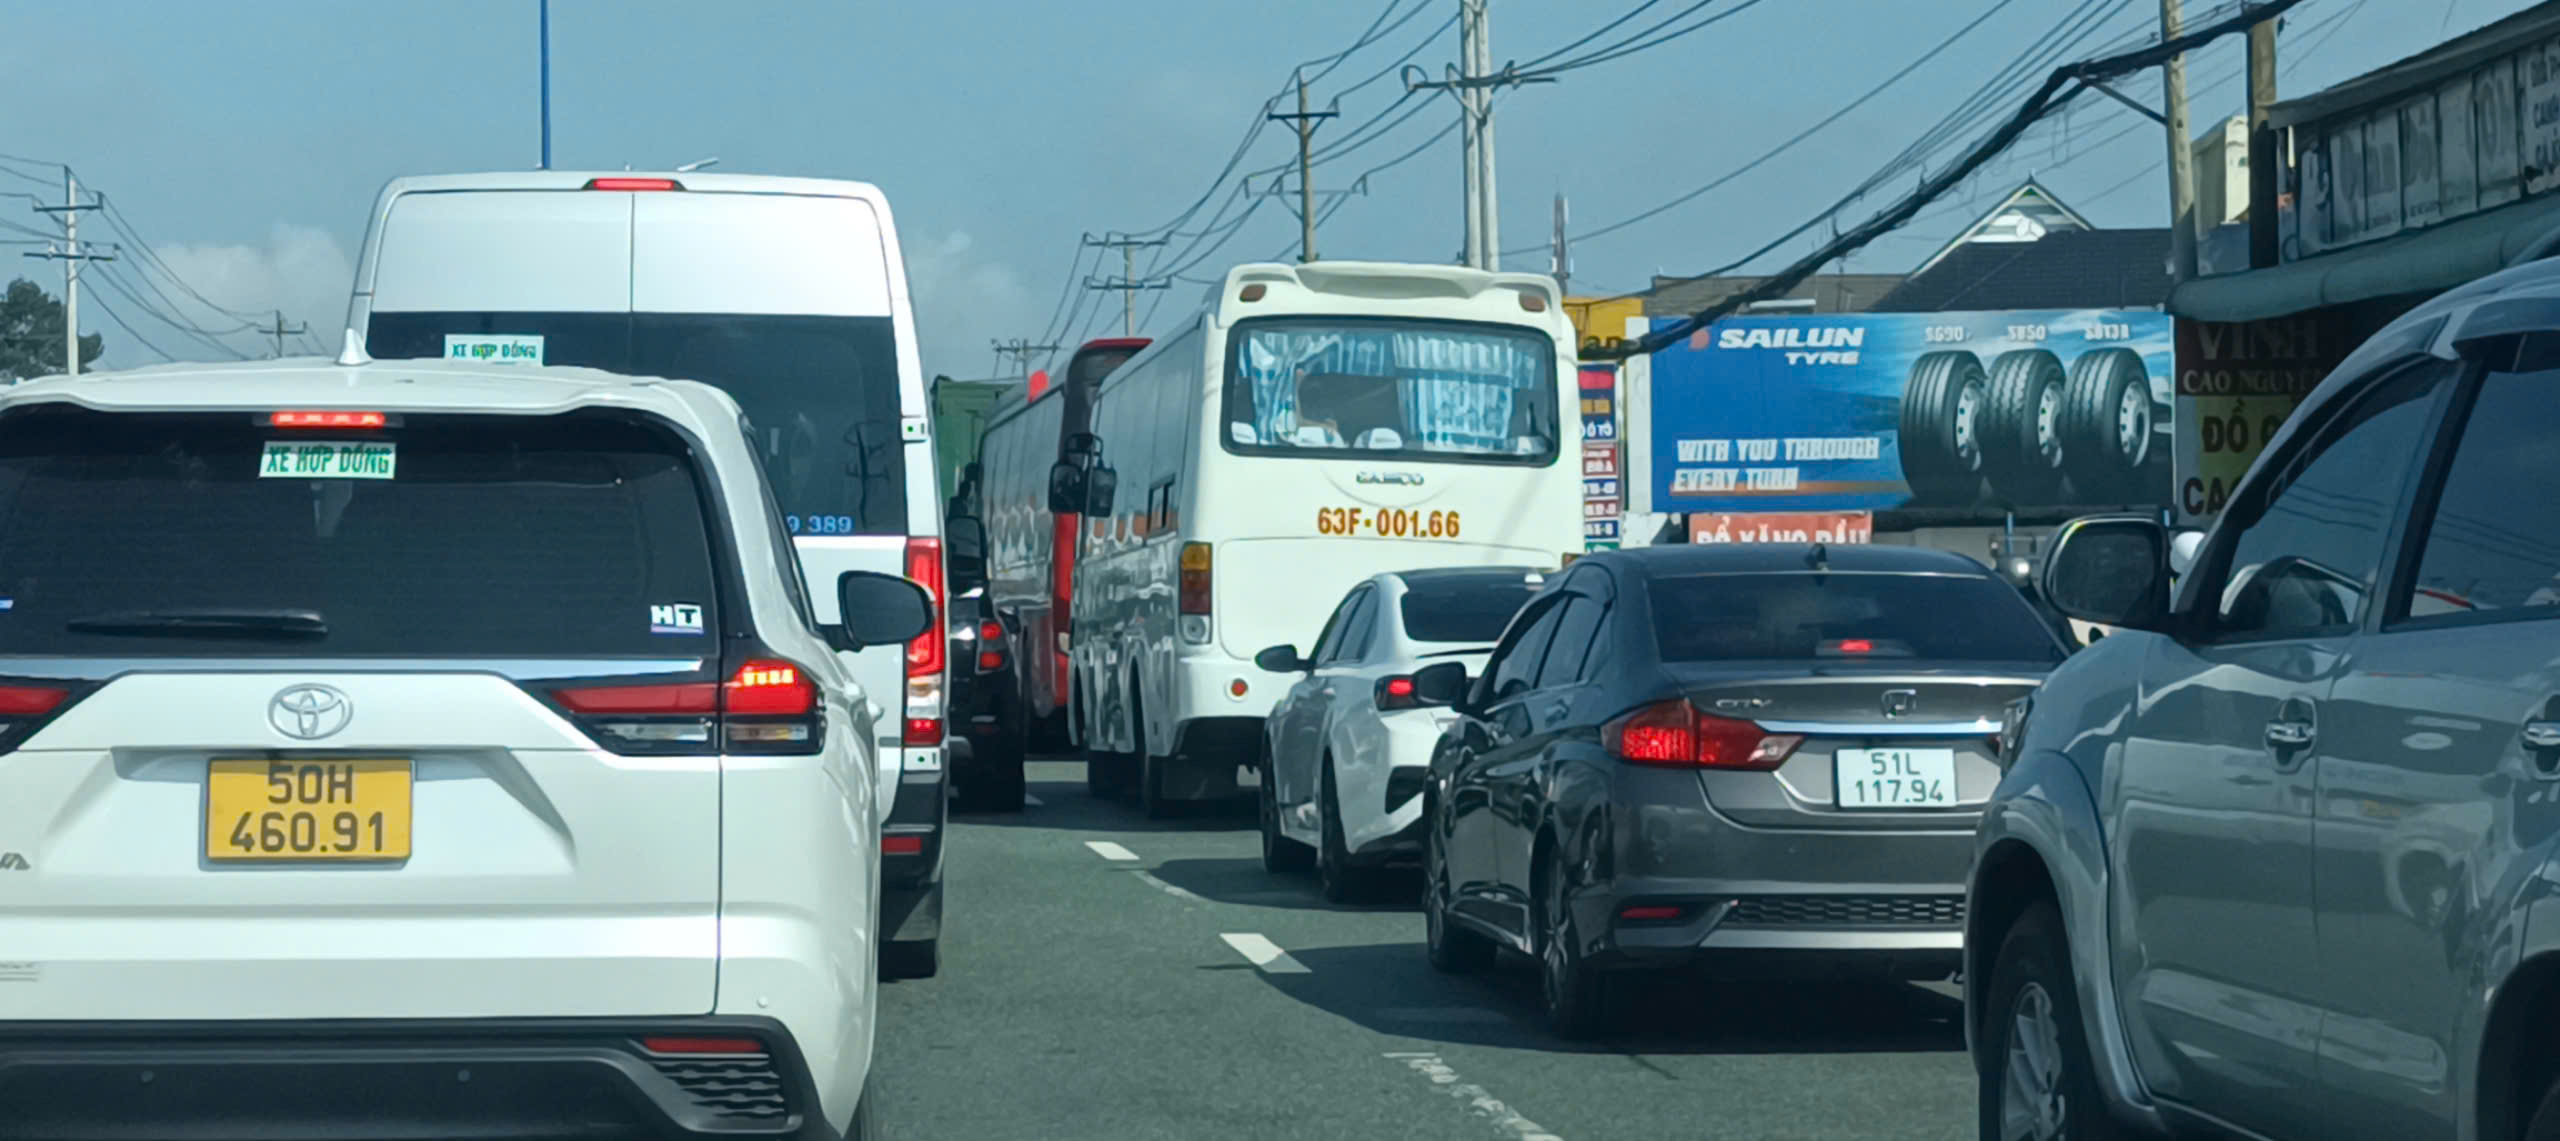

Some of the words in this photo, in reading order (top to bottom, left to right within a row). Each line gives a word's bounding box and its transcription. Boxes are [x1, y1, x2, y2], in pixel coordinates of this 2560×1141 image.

[1718, 327, 1865, 348] SAILUN
[1785, 351, 1859, 365] TYRE
[2183, 369, 2231, 393] CAO
[2202, 398, 2249, 454] ĐỒ
[266, 446, 290, 473] XE
[295, 443, 335, 474] HỢP
[1677, 439, 1731, 462] WITH
[1736, 438, 1779, 461] YOU
[1673, 468, 1739, 491] EVERY
[2183, 476, 2244, 517] CA
[808, 515, 853, 533] 389
[1870, 752, 1921, 776] 51L
[267, 764, 353, 804] 50H
[1855, 779, 1944, 803] 117.94
[230, 811, 384, 853] 460.91
